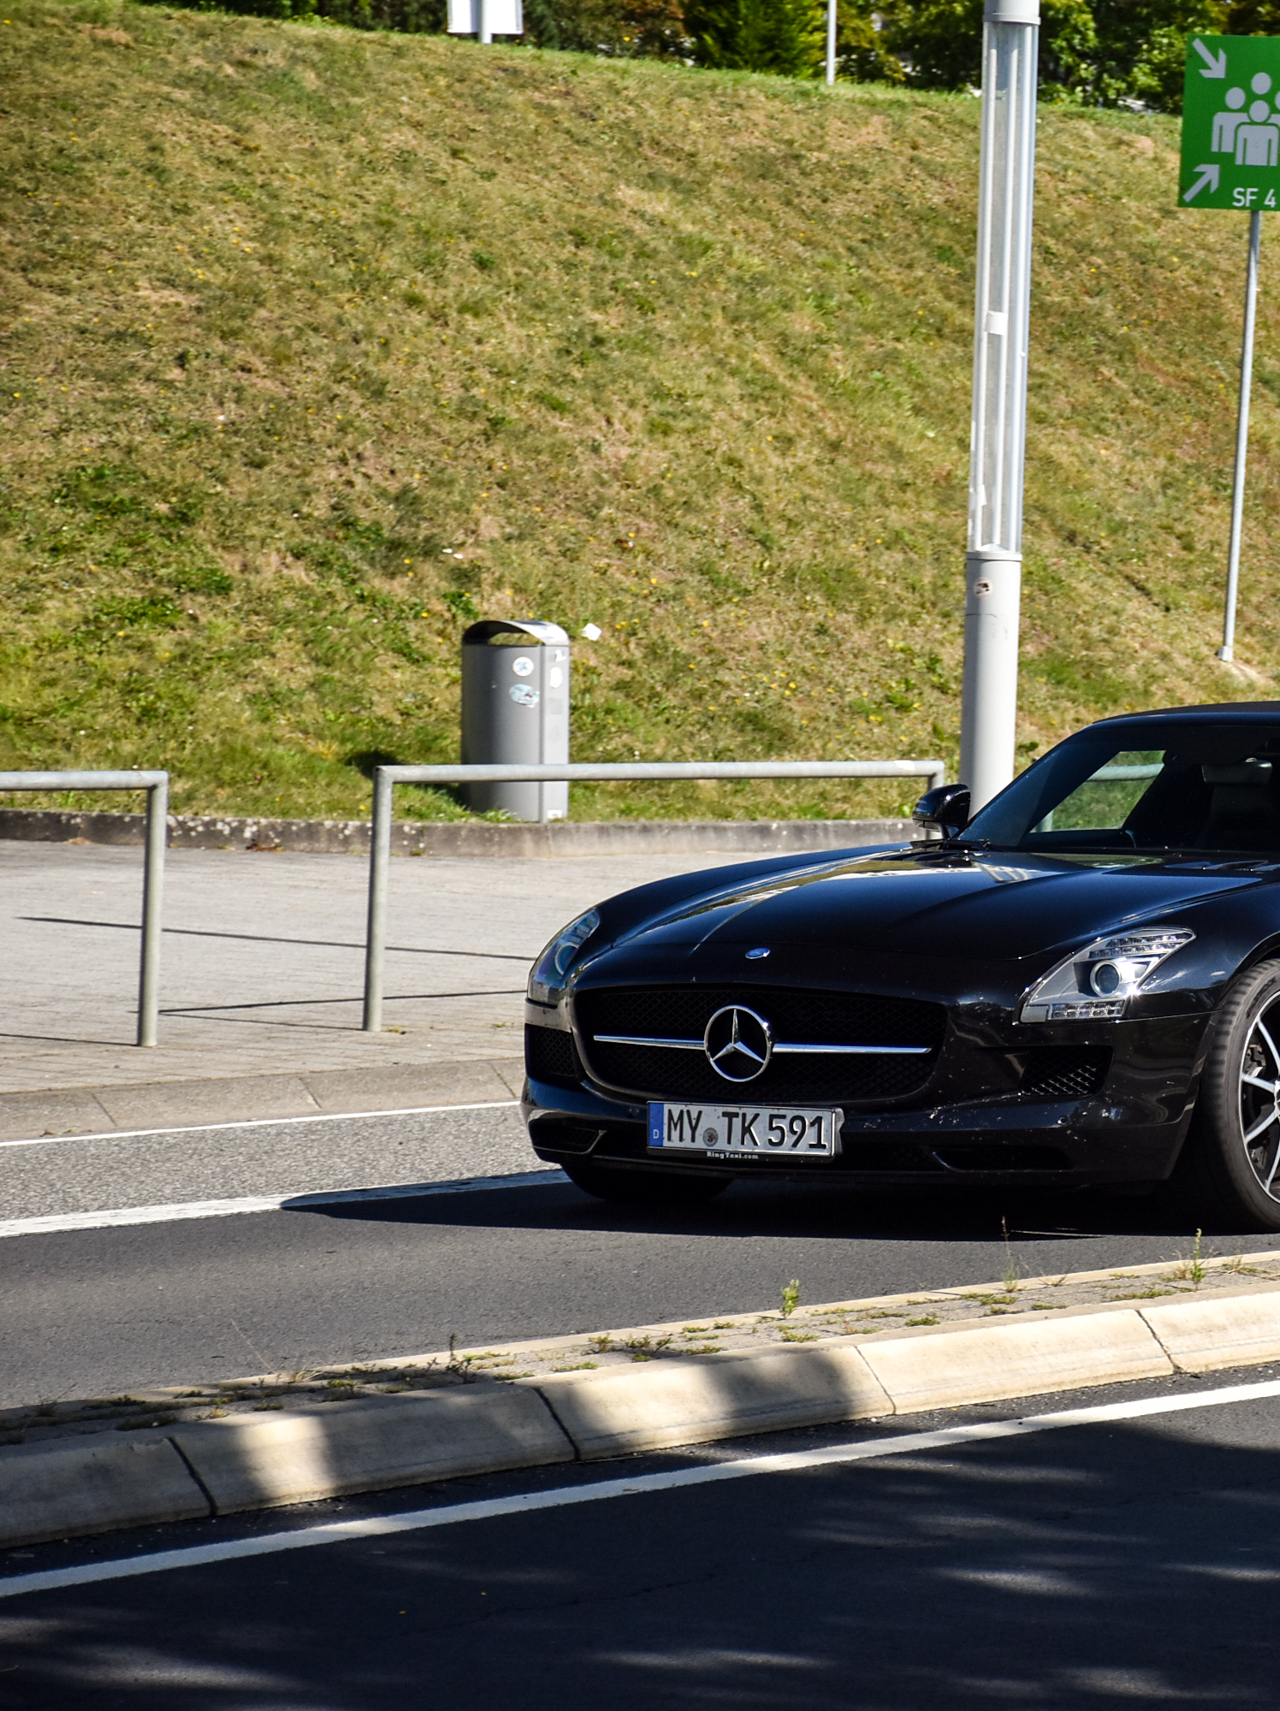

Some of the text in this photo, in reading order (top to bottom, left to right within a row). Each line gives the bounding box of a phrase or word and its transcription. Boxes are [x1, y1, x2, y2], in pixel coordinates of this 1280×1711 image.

[1232, 187, 1277, 208] SF 4
[653, 1129, 659, 1139] D
[667, 1108, 827, 1149] MY TK 591
[706, 1150, 759, 1159] RingTaxi.com
